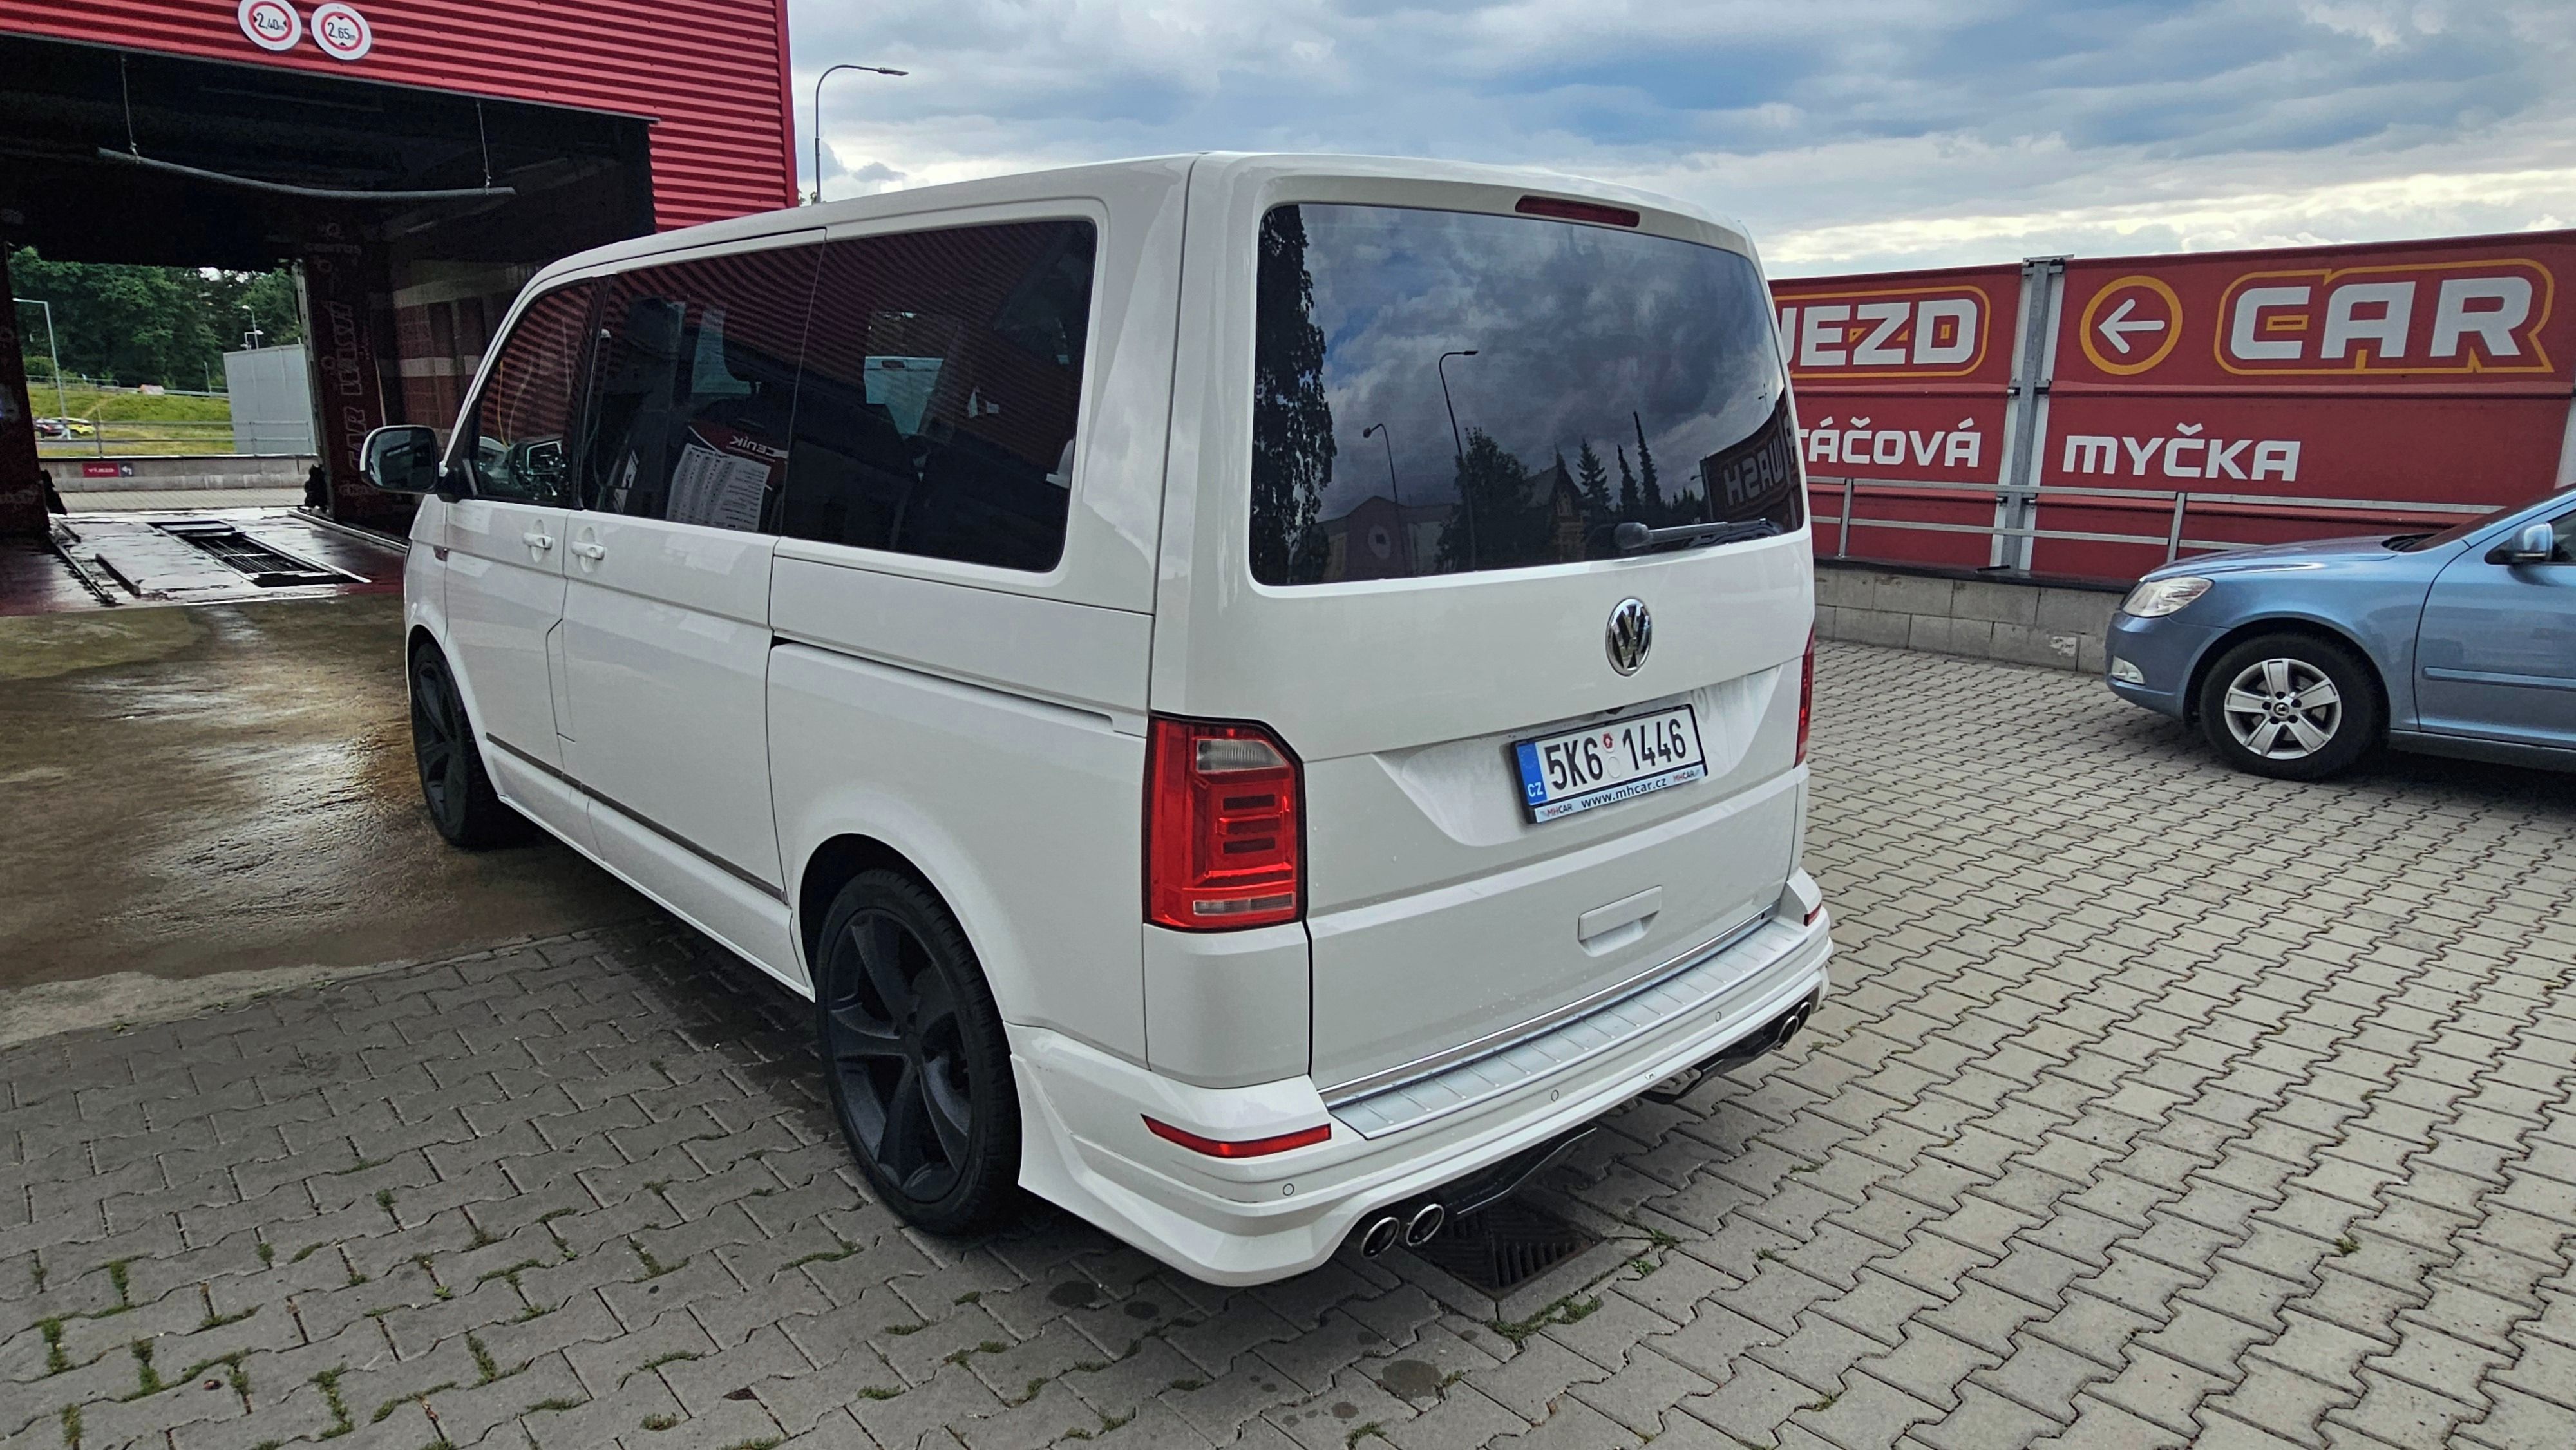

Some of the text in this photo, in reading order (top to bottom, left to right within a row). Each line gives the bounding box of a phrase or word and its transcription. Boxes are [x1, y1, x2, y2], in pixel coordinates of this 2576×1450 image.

[2230, 276, 2533, 359] CAR
[1799, 415, 1982, 467] ÁČOVÁ
[2062, 422, 2302, 482] MYČKA
[1544, 718, 1687, 791] 5K6 1446
[1527, 781, 1544, 798] CZ
[1581, 778, 1667, 808] www.mhcar.cz
